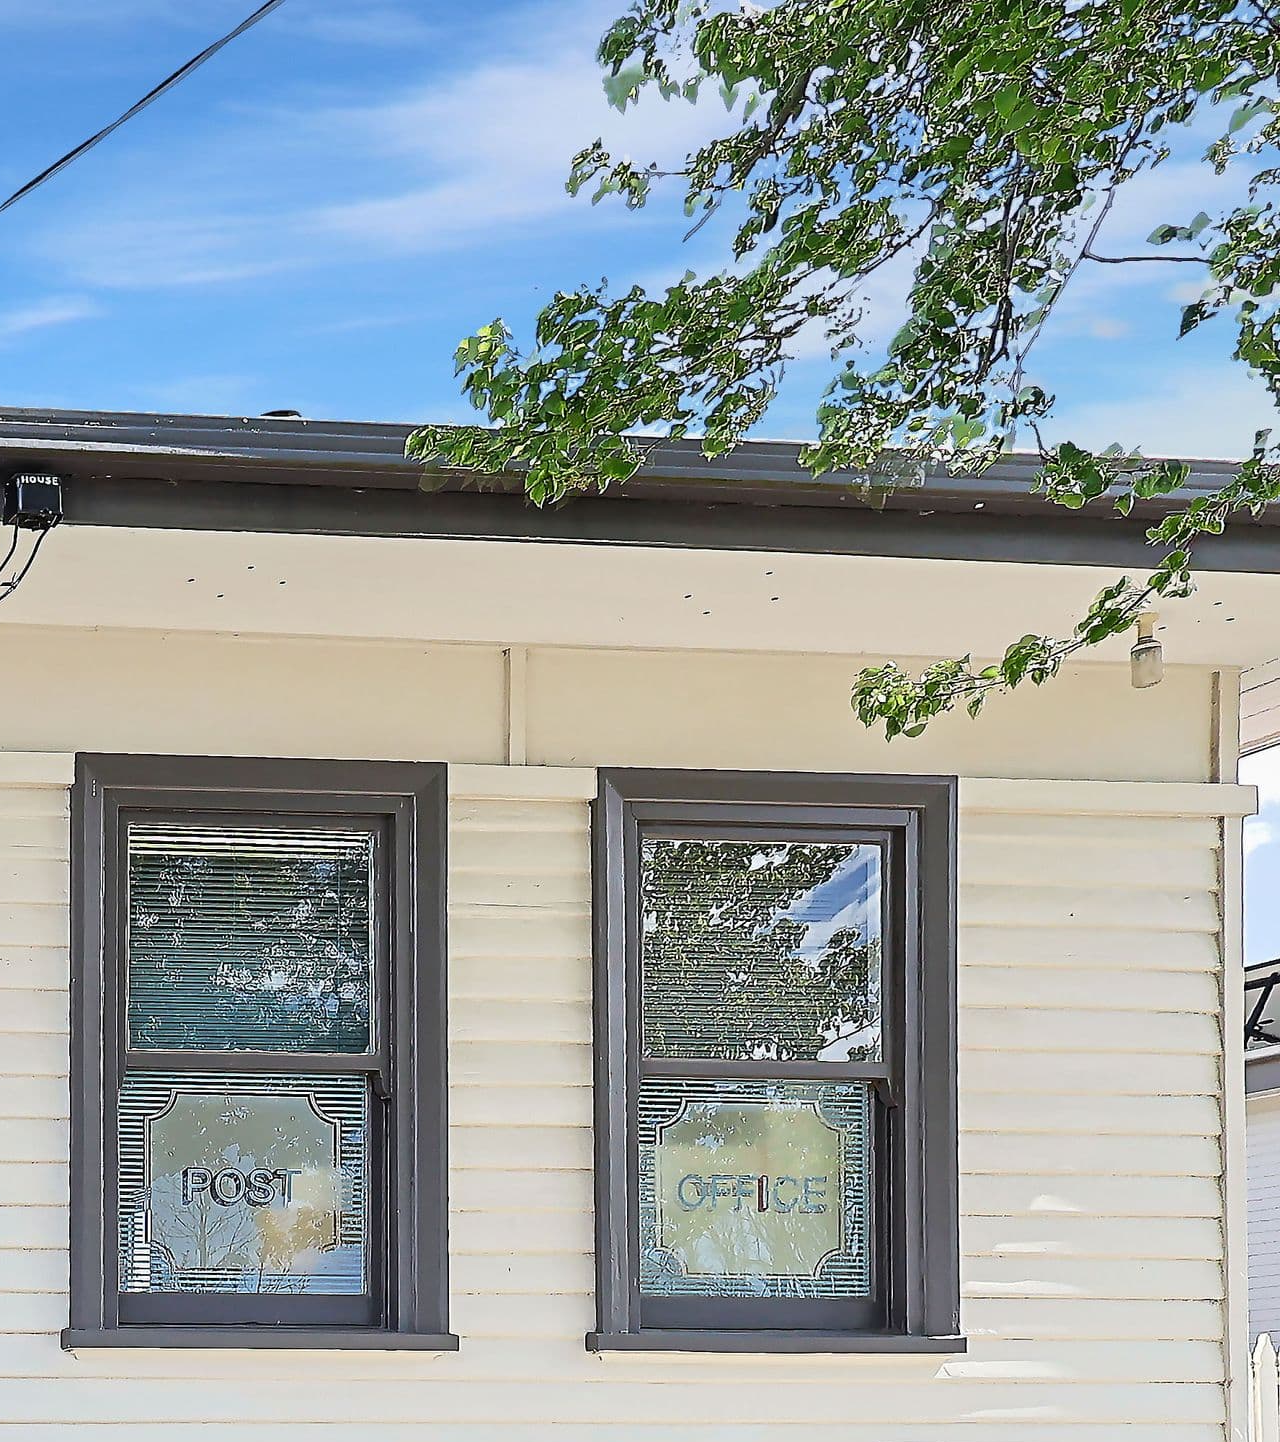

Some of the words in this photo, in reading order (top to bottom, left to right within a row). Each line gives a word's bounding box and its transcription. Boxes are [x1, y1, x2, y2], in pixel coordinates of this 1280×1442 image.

[20, 475, 59, 486] HOUSE
[181, 1167, 302, 1207] POST
[677, 1174, 828, 1213] OFFICE
